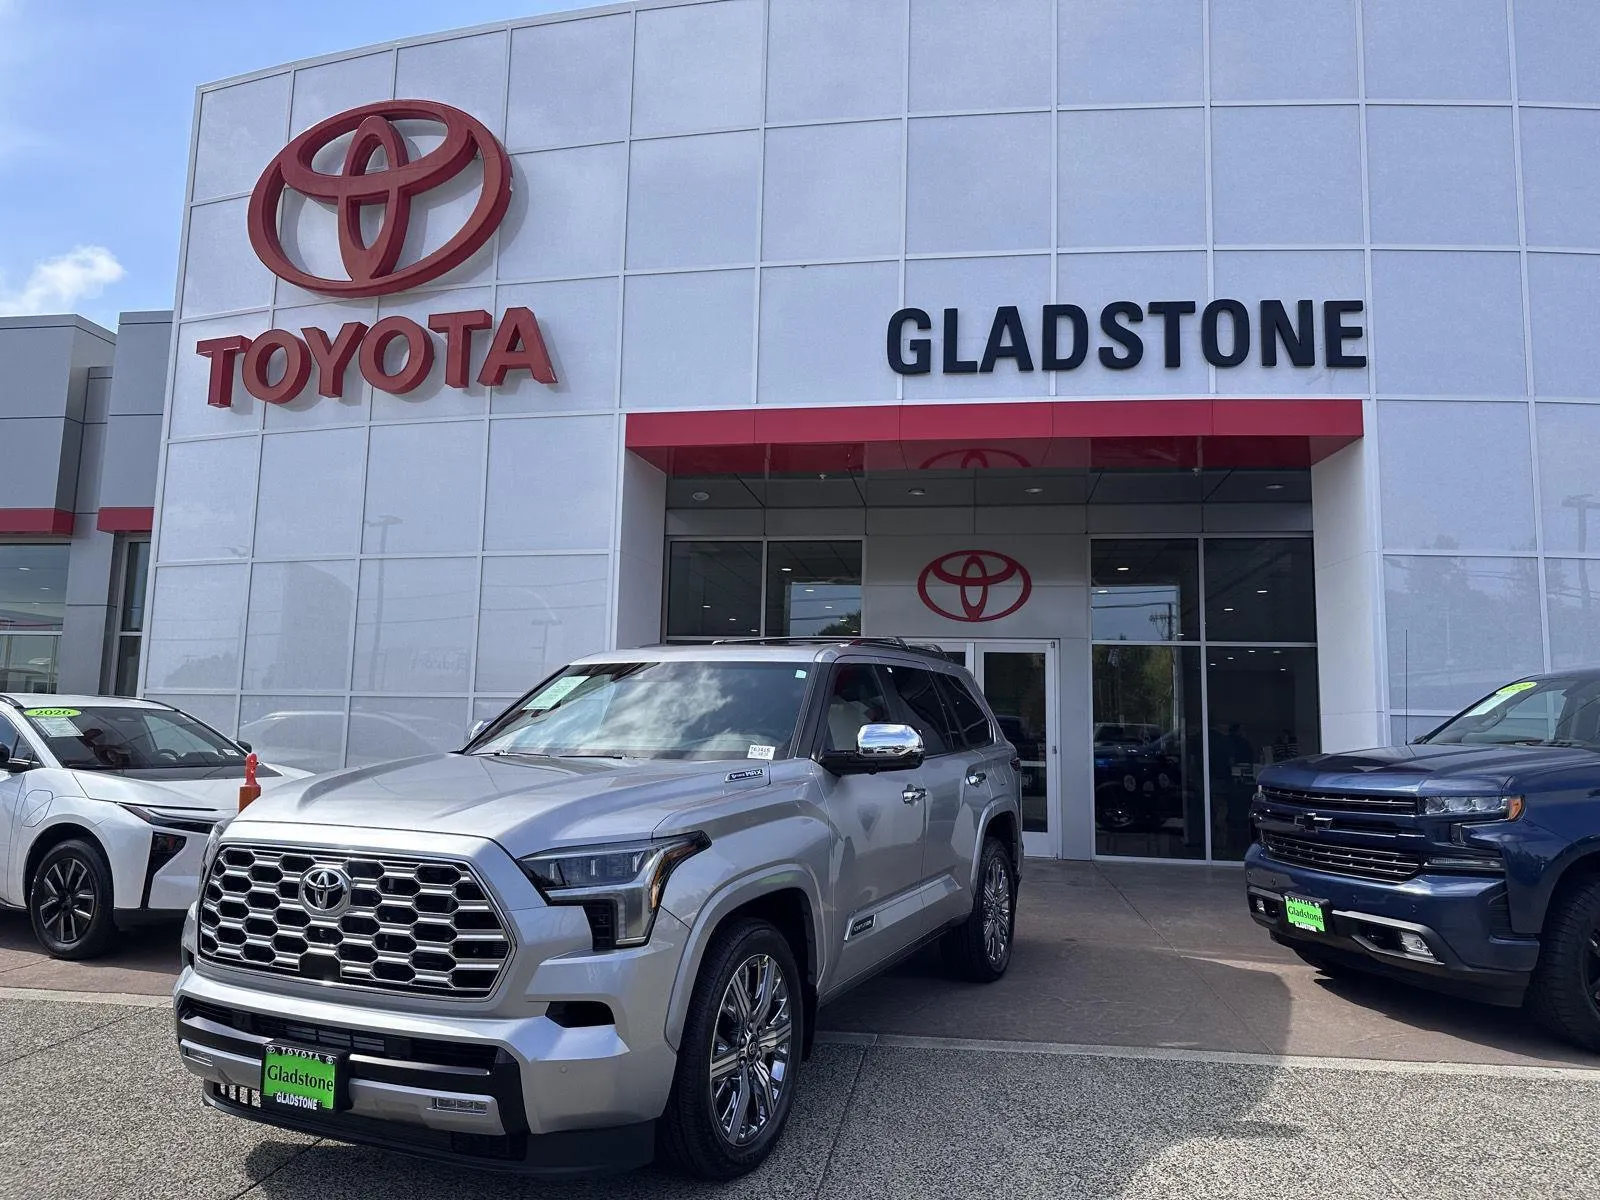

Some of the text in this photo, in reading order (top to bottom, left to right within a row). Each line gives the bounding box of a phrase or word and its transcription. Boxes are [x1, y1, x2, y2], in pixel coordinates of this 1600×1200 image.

[887, 299, 1367, 375] GLADSTONE
[196, 306, 559, 409] TOYOTA
[1288, 906, 1323, 922] Gladstone
[281, 1047, 320, 1060] TOYOTA
[267, 1065, 333, 1091] Gladstone
[276, 1092, 317, 1110] GLADSTONE
